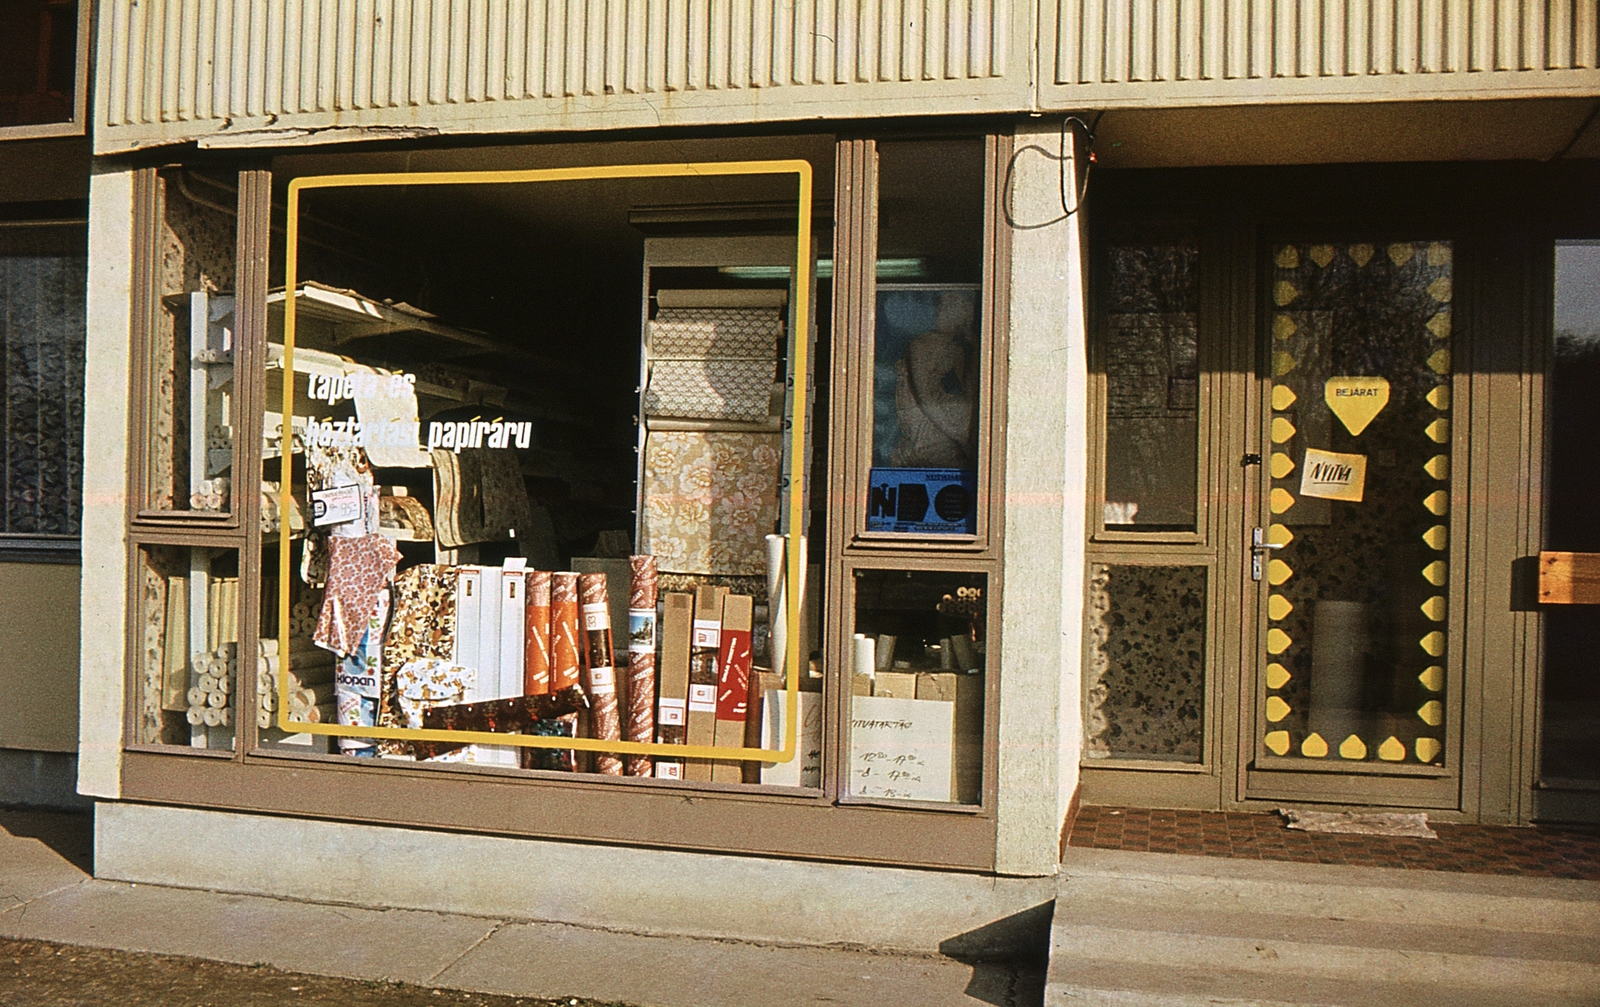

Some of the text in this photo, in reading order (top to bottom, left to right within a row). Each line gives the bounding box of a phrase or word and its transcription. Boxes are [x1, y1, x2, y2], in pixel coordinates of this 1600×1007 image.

[308, 369, 416, 405] tapéta és
[1336, 387, 1378, 396] BEJÁRAT
[305, 415, 532, 453] háztartási papíráru
[1310, 461, 1352, 482] NYITVA
